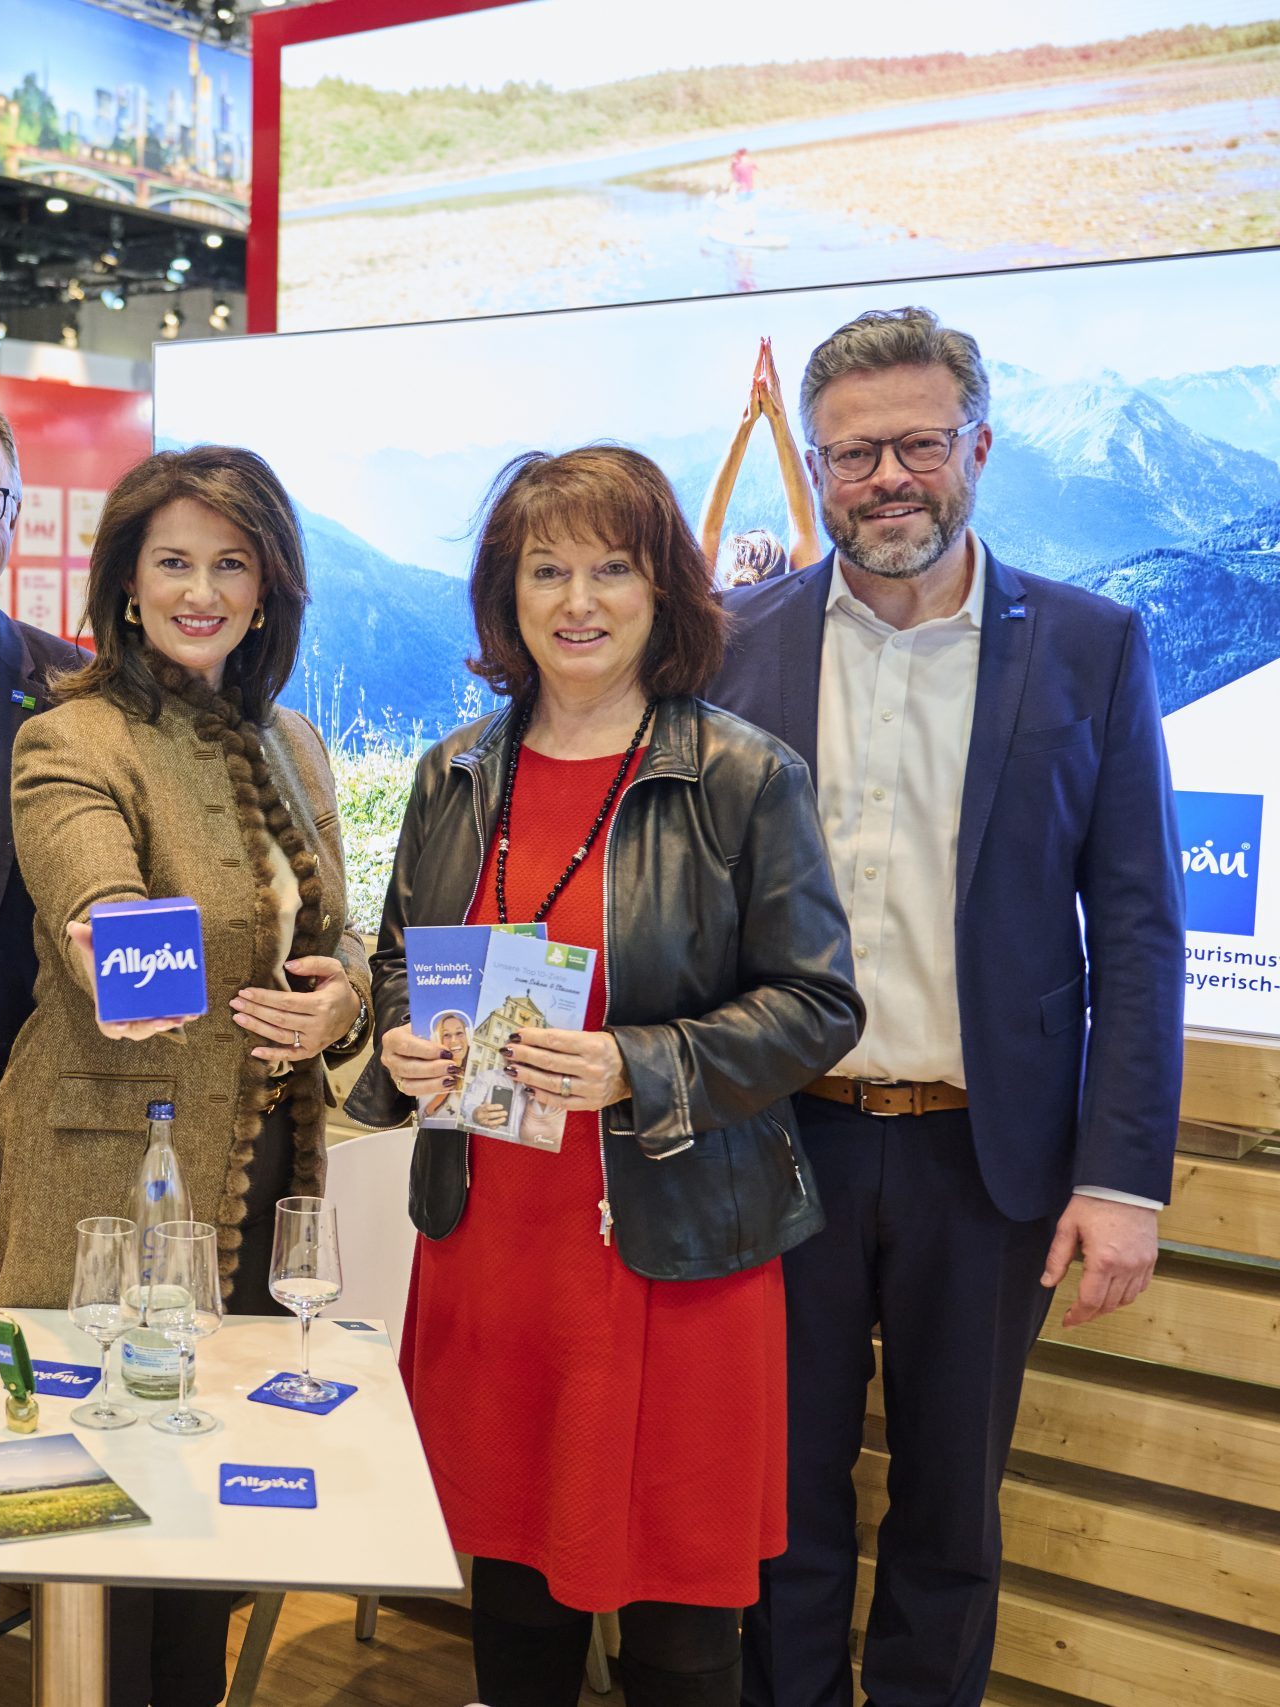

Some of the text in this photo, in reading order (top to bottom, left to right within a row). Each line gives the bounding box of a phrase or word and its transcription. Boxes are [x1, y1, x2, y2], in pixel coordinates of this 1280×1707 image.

[100, 942, 198, 989] Allgäu
[1185, 946, 1280, 967] ourismus
[413, 963, 433, 972] Wer
[1185, 972, 1280, 992] ayerisch-
